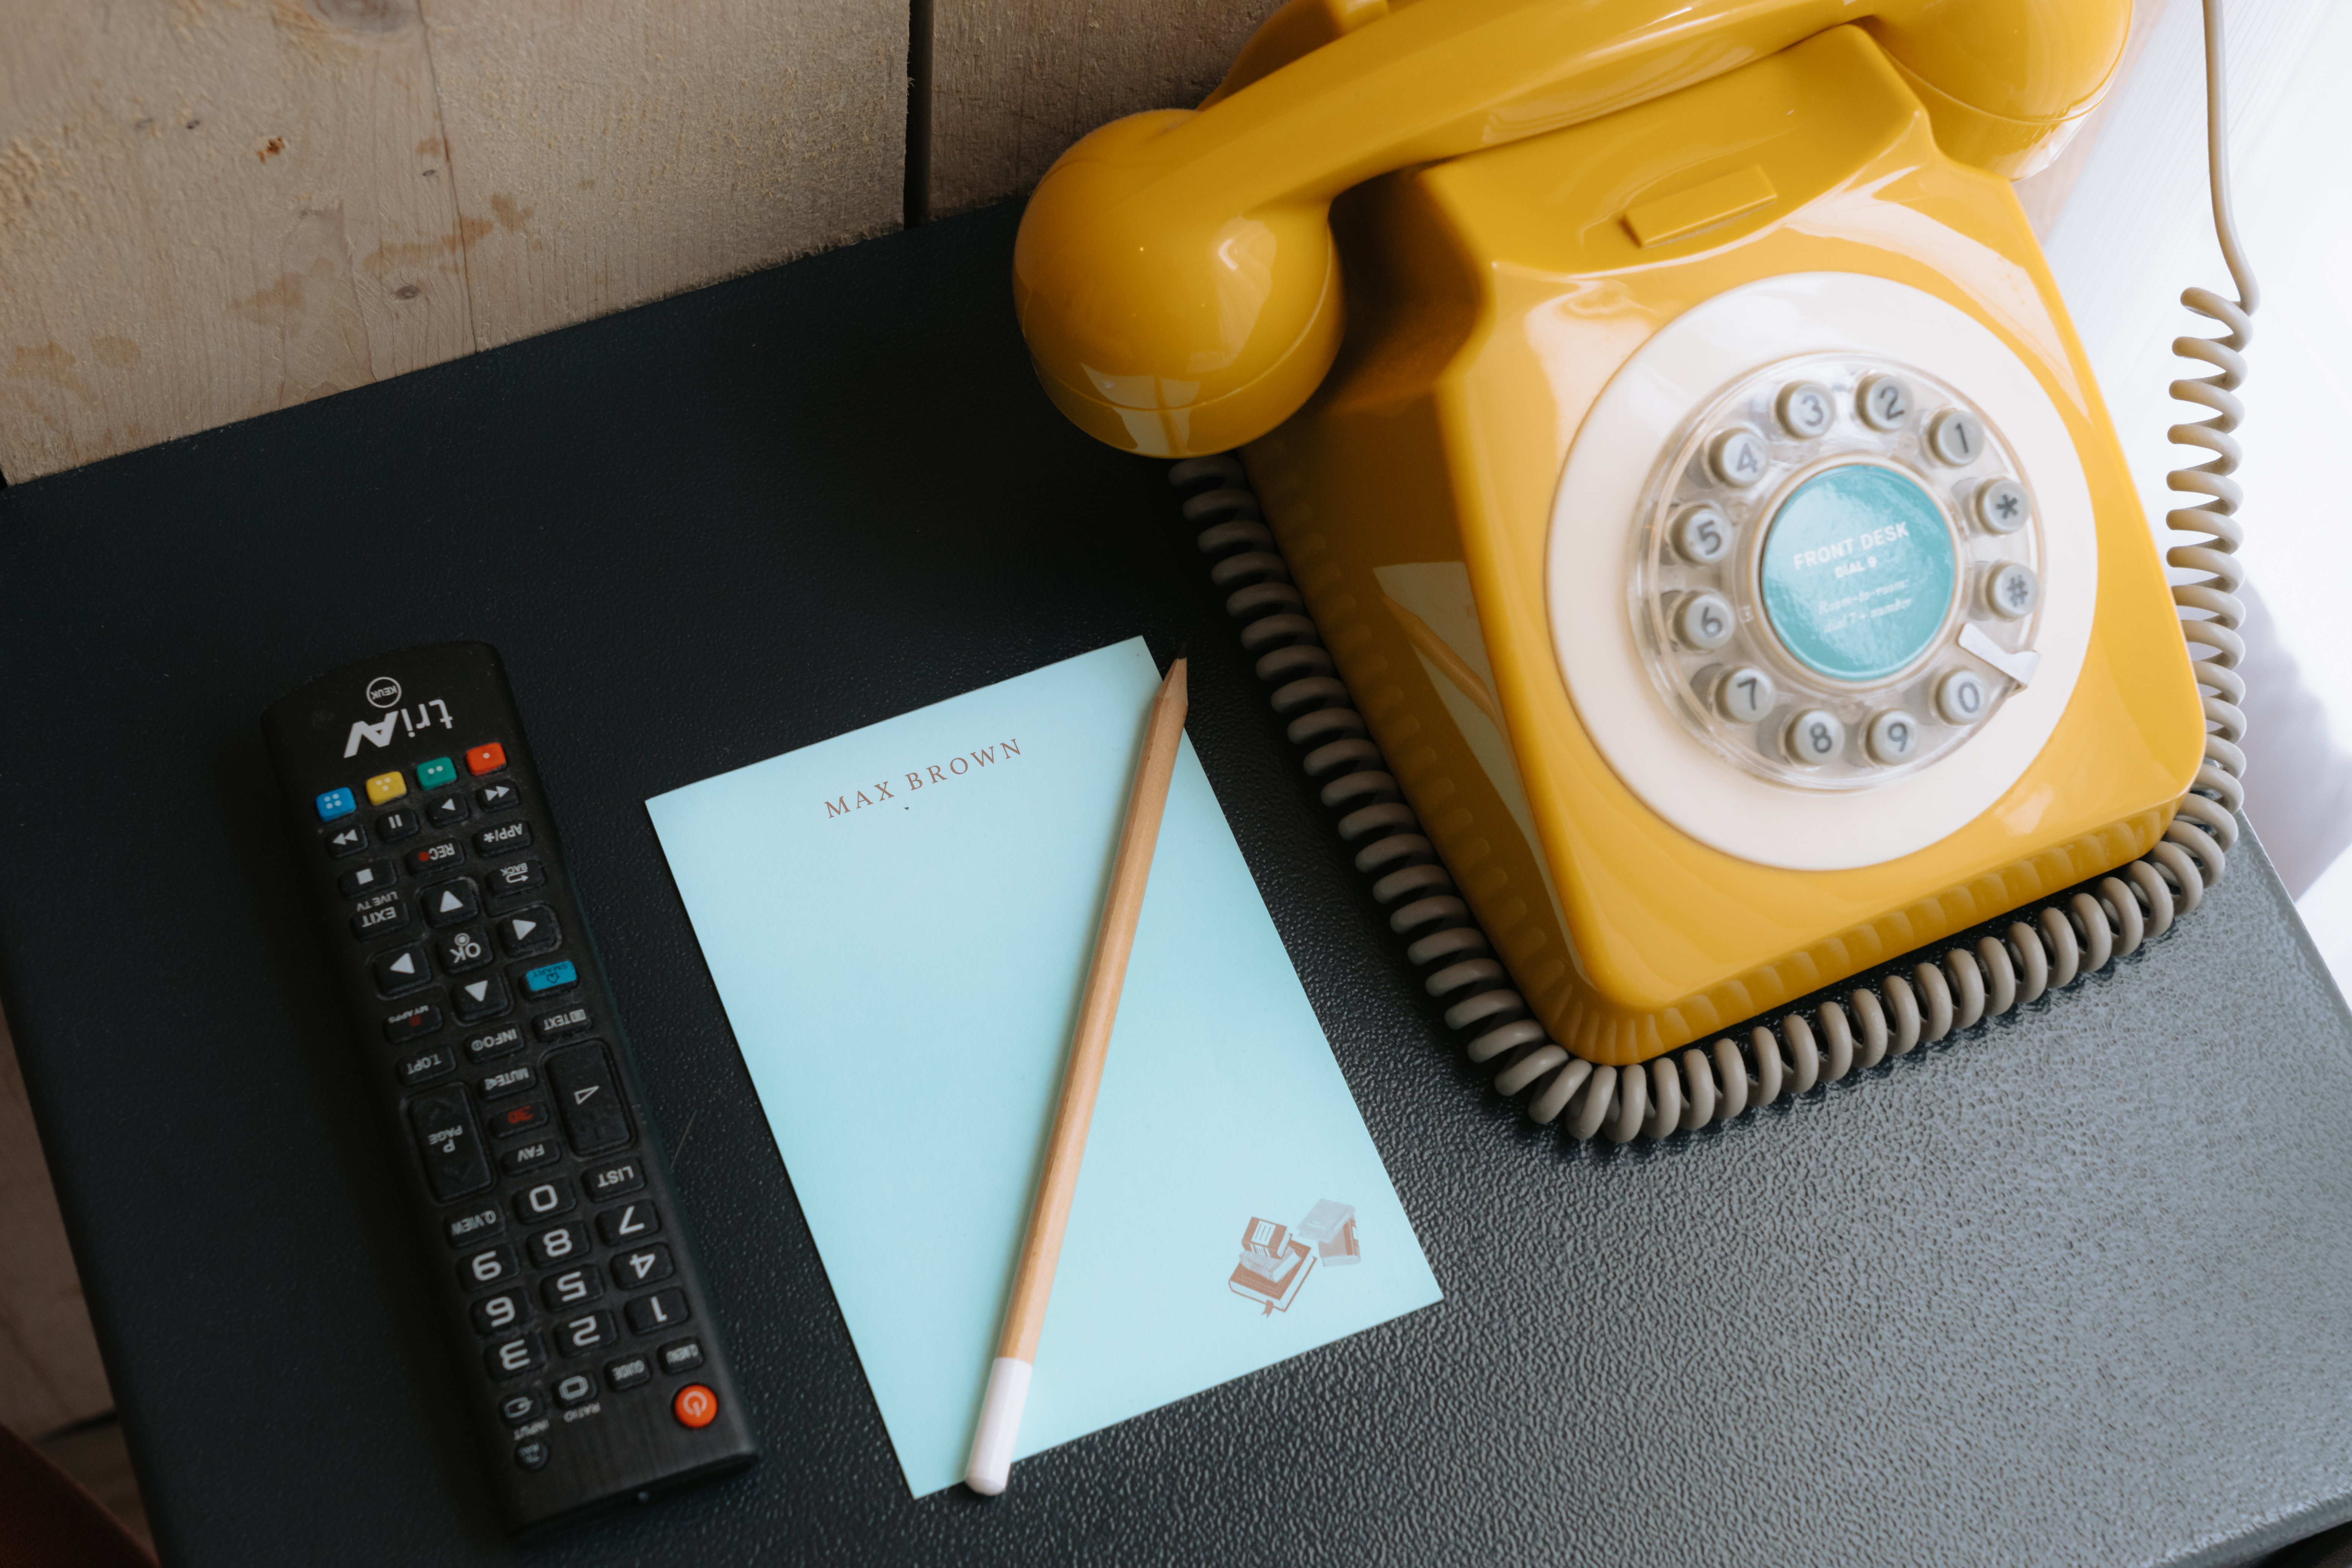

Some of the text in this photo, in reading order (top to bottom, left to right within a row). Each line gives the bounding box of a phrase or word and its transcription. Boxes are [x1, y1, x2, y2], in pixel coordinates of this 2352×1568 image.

[1801, 394, 1823, 427] 3
[1880, 387, 1905, 420] 2
[1955, 422, 1969, 454] 1
[1736, 442, 1758, 474] 4
[1696, 519, 1722, 556] 5
[1793, 521, 1910, 570] FRONT DESK
[1834, 556, 1878, 578] DIAL 9
[1700, 607, 1723, 638] 6
[370, 685, 397, 700] KEUK
[1737, 677, 1757, 711] 7
[1957, 682, 1980, 713] 0
[1810, 722, 1833, 754] 8
[1886, 722, 1908, 753] 9
[824, 738, 1021, 819] MAX BROWN
[428, 843, 455, 860] REC
[500, 862, 528, 876] BACK
[356, 891, 398, 912] LIVE TV
[361, 906, 397, 927] EXIT
[449, 942, 482, 963] OK
[533, 963, 568, 978] SMART
[388, 1005, 429, 1023] MY APPS
[543, 1013, 569, 1030] TEXT
[483, 1028, 517, 1048] INFO
[406, 1053, 442, 1075] T.OPT
[496, 1067, 529, 1087] MUTE
[428, 1125, 463, 1145] PAGE
[442, 1139, 455, 1153] P
[517, 1144, 545, 1162] FAV
[597, 1165, 634, 1188] LIST
[529, 1184, 558, 1213] 0
[451, 1210, 497, 1236] Q.VIEW
[618, 1205, 645, 1235] 7
[543, 1228, 572, 1258] 8
[472, 1250, 502, 1281] 9
[629, 1253, 656, 1279] 4
[556, 1272, 587, 1302] 5
[485, 1296, 515, 1327] 6
[650, 1296, 668, 1322] 1
[568, 1316, 601, 1346] 2
[499, 1339, 531, 1370] 3
[612, 1360, 644, 1381] GUIDE
[564, 1402, 601, 1422] RATIO
[514, 1419, 549, 1440] INPUT
